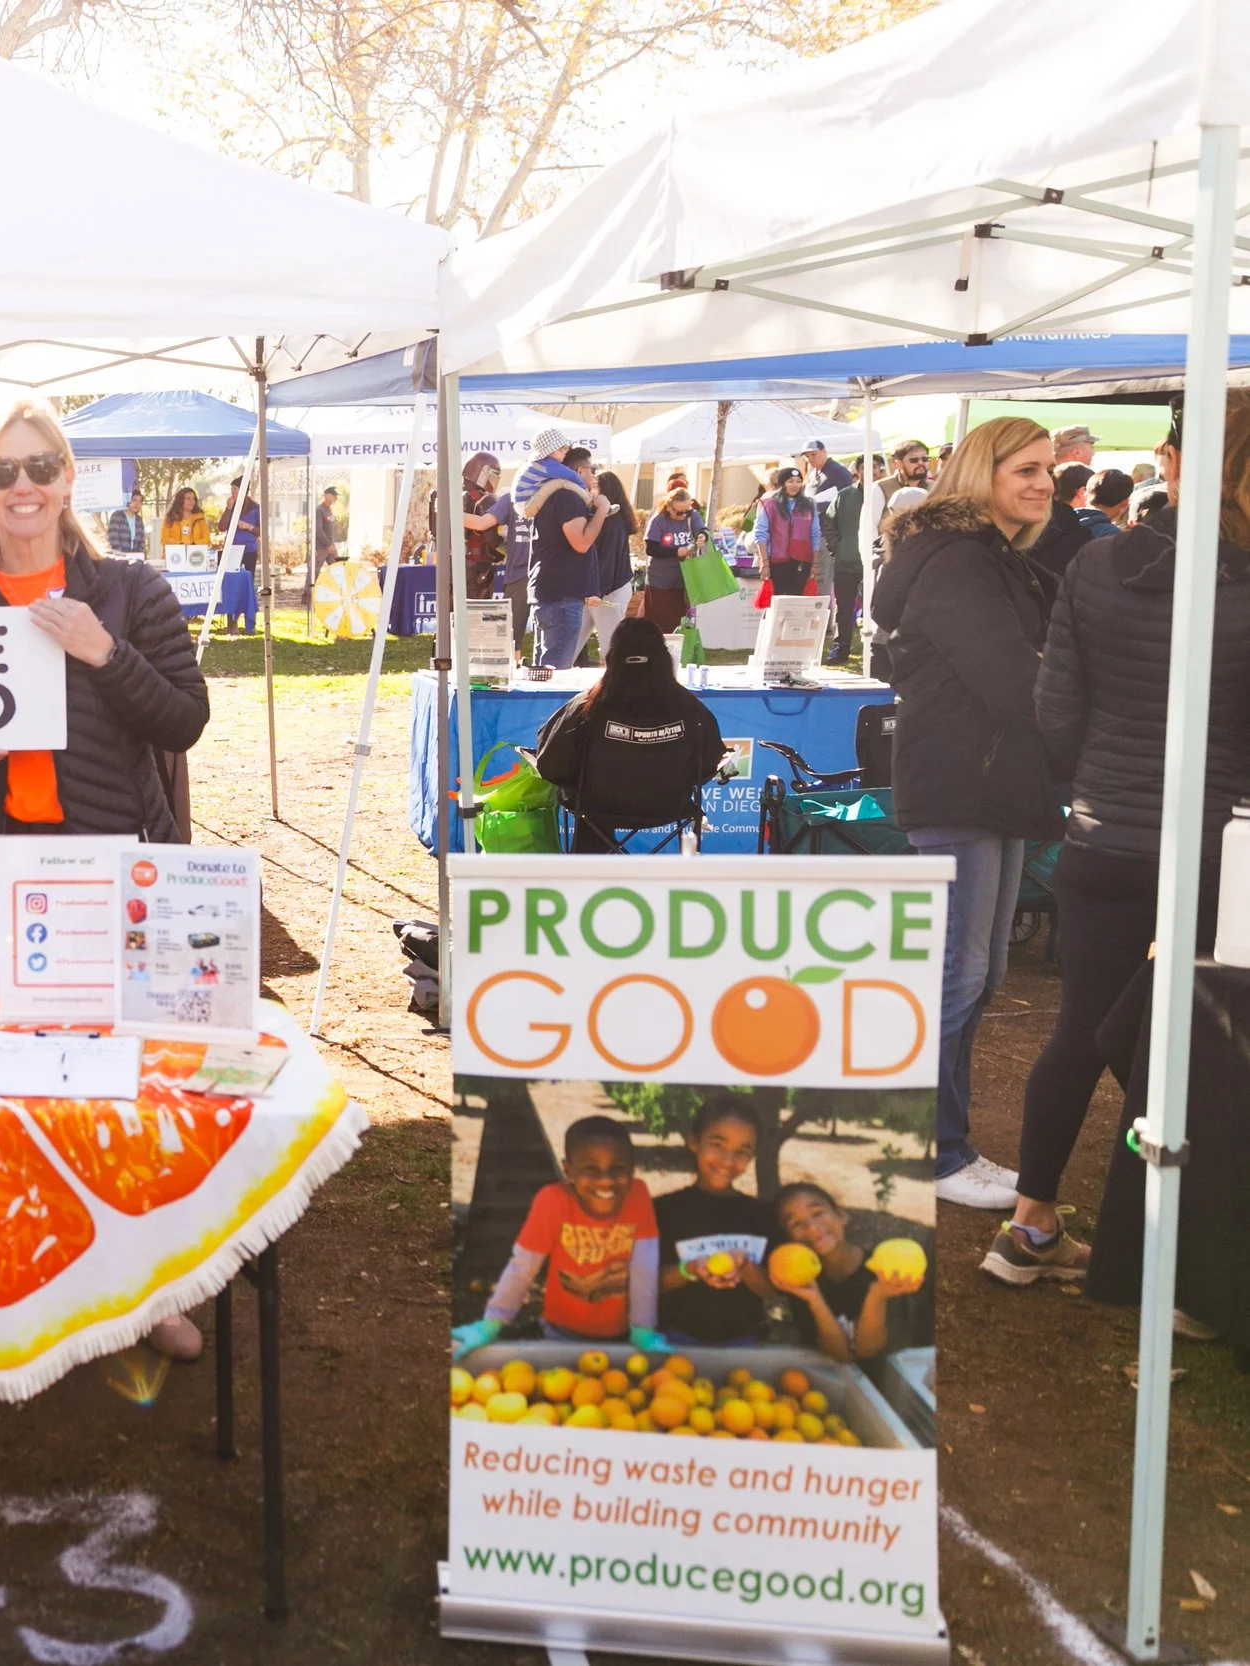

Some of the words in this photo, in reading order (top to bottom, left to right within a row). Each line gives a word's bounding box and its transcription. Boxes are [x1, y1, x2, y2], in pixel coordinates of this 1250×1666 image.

[77, 463, 103, 474] SAFE
[326, 442, 409, 456] INTERFAIT
[722, 800, 761, 813] DIEG
[187, 860, 231, 874] Donate
[232, 863, 247, 874] to
[468, 887, 933, 963] PRODUCE
[466, 968, 927, 1078] GOOD
[463, 1441, 613, 1486] Reducing
[624, 1457, 717, 1487] waste
[728, 1463, 794, 1493] and
[803, 1464, 922, 1507] hunger
[481, 1487, 562, 1519] while
[572, 1492, 702, 1537] building
[712, 1510, 902, 1553] community
[462, 1545, 926, 1618] www.producegood.org
